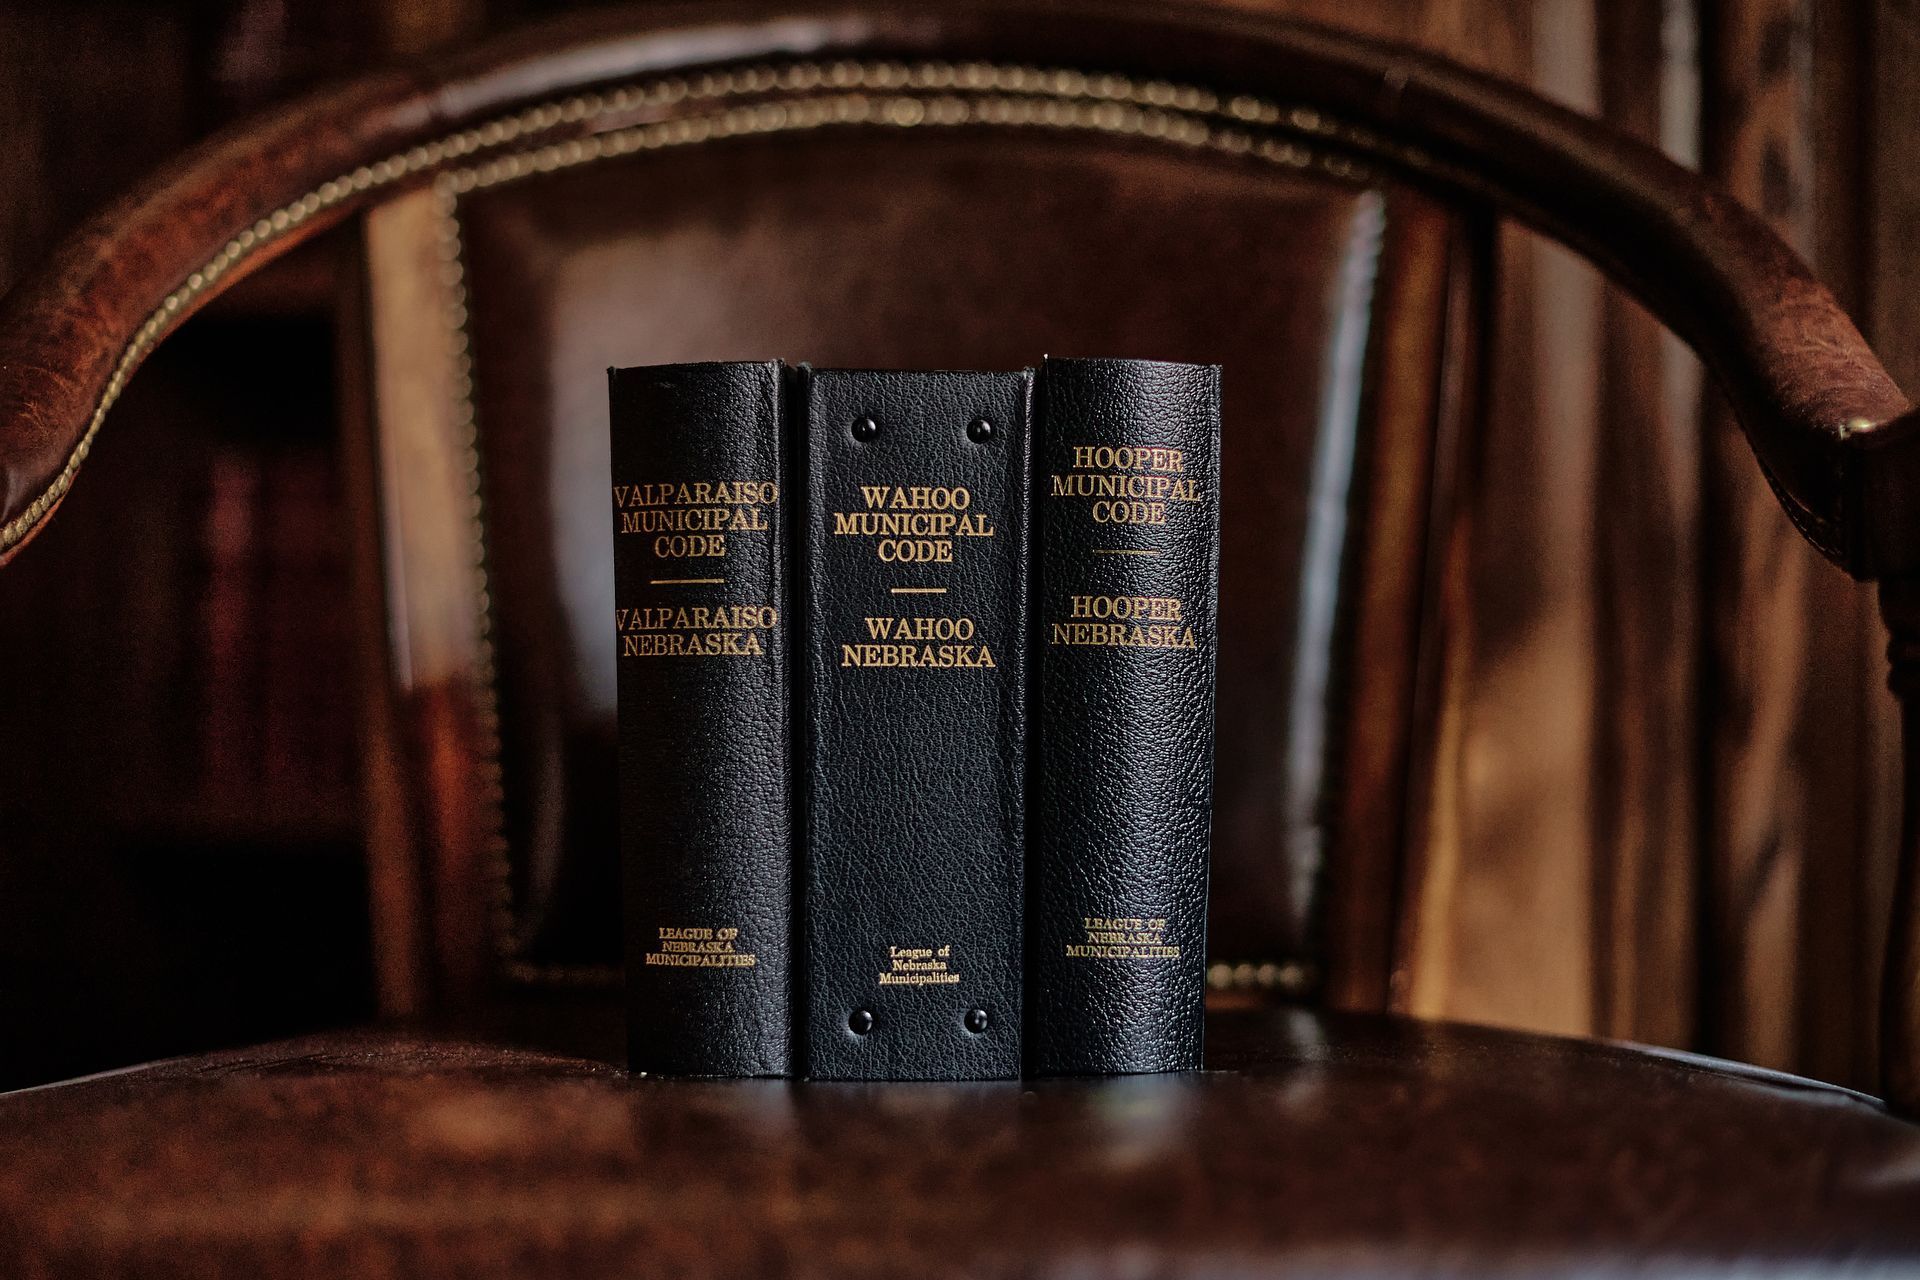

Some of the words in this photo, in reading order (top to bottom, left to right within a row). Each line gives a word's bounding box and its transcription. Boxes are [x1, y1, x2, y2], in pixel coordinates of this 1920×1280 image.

[1073, 446, 1184, 473] HOOPER
[613, 481, 779, 508] VALPARAISO
[860, 486, 971, 510] WAHOO
[1051, 474, 1201, 501] MUNICIPAL
[621, 508, 769, 534] MUNICIPAL
[833, 512, 995, 537] MUNICIPAL
[1092, 500, 1166, 525] CODE
[654, 534, 726, 558] CODE
[877, 539, 953, 563] CODE
[615, 605, 778, 631] VALPARAISO
[1070, 595, 1182, 621] HOOPER
[864, 617, 975, 641] WAHOO
[1051, 623, 1196, 649] NEBRASKA
[623, 632, 764, 657] NEBRASKA
[841, 644, 996, 668] NEBRASKA
[658, 927, 713, 940] LEAGUE
[716, 927, 739, 940] OF
[1084, 917, 1142, 930] LEAGUE
[1147, 918, 1166, 931] OF
[661, 940, 736, 953] NEBRASKA
[1087, 931, 1163, 945] NEBRASKA
[645, 952, 757, 967] MUNICIPALITIES
[890, 945, 933, 959] League
[938, 944, 951, 957] of
[1065, 944, 1180, 959] MUNICIPALITIES
[892, 959, 947, 971] Nebraska
[879, 972, 960, 986] Municipalities
